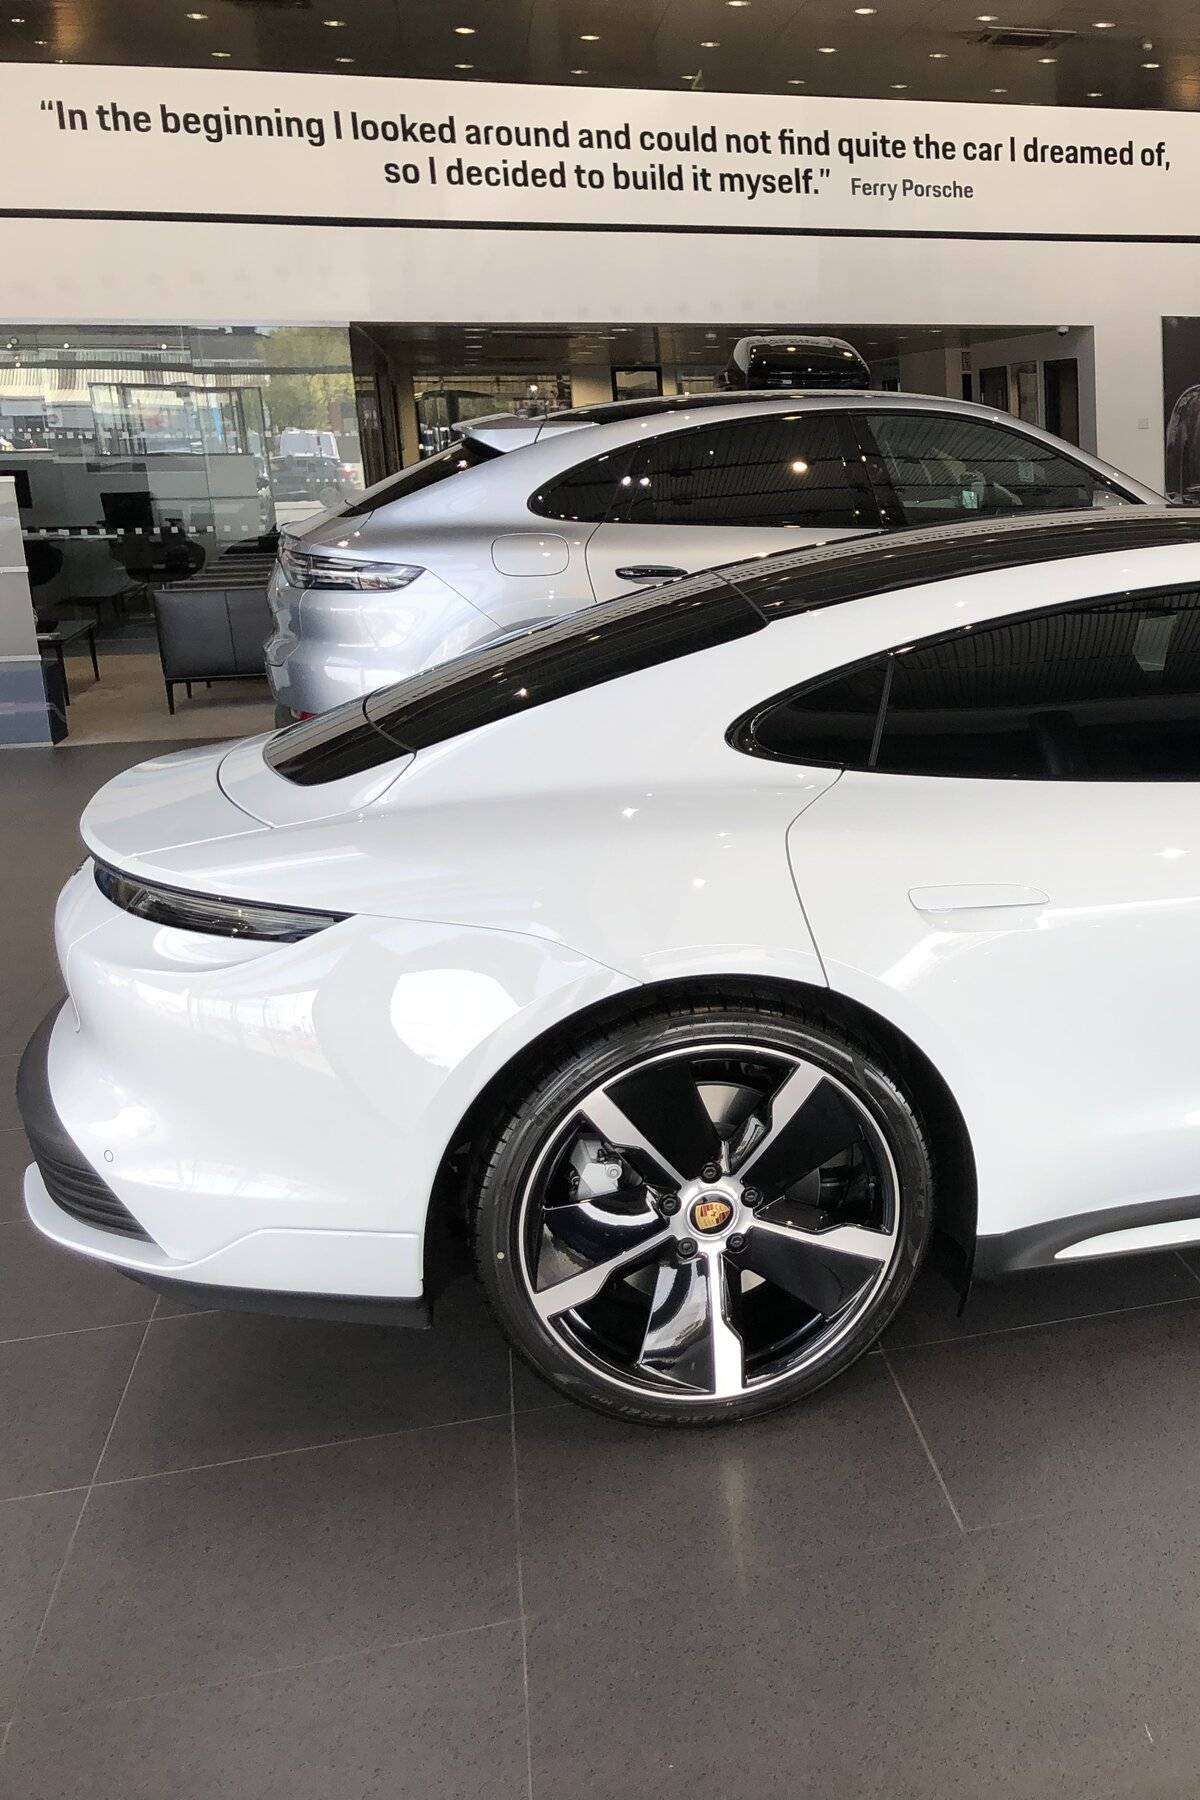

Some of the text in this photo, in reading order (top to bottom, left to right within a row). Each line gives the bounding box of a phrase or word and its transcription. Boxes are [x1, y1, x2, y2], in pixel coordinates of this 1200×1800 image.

[95, 102, 152, 133] the
[159, 103, 326, 147] beginning
[333, 110, 343, 140] I
[350, 111, 457, 144] looked
[464, 120, 570, 148] around
[578, 122, 631, 150] and
[639, 125, 718, 153] could
[725, 130, 772, 155] not
[777, 128, 830, 157] find
[837, 131, 907, 165] quite
[912, 133, 956, 161] the
[962, 141, 1004, 162] car
[1009, 136, 1016, 162] I
[1023, 136, 1134, 166] dreamed
[1140, 141, 1171, 171] of,
[384, 162, 420, 185] so
[428, 156, 437, 185] I
[446, 157, 567, 189] decided
[573, 164, 605, 190] to
[612, 162, 684, 192] build
[691, 164, 713, 192] it
[851, 177, 974, 201] Ferry Porsche
